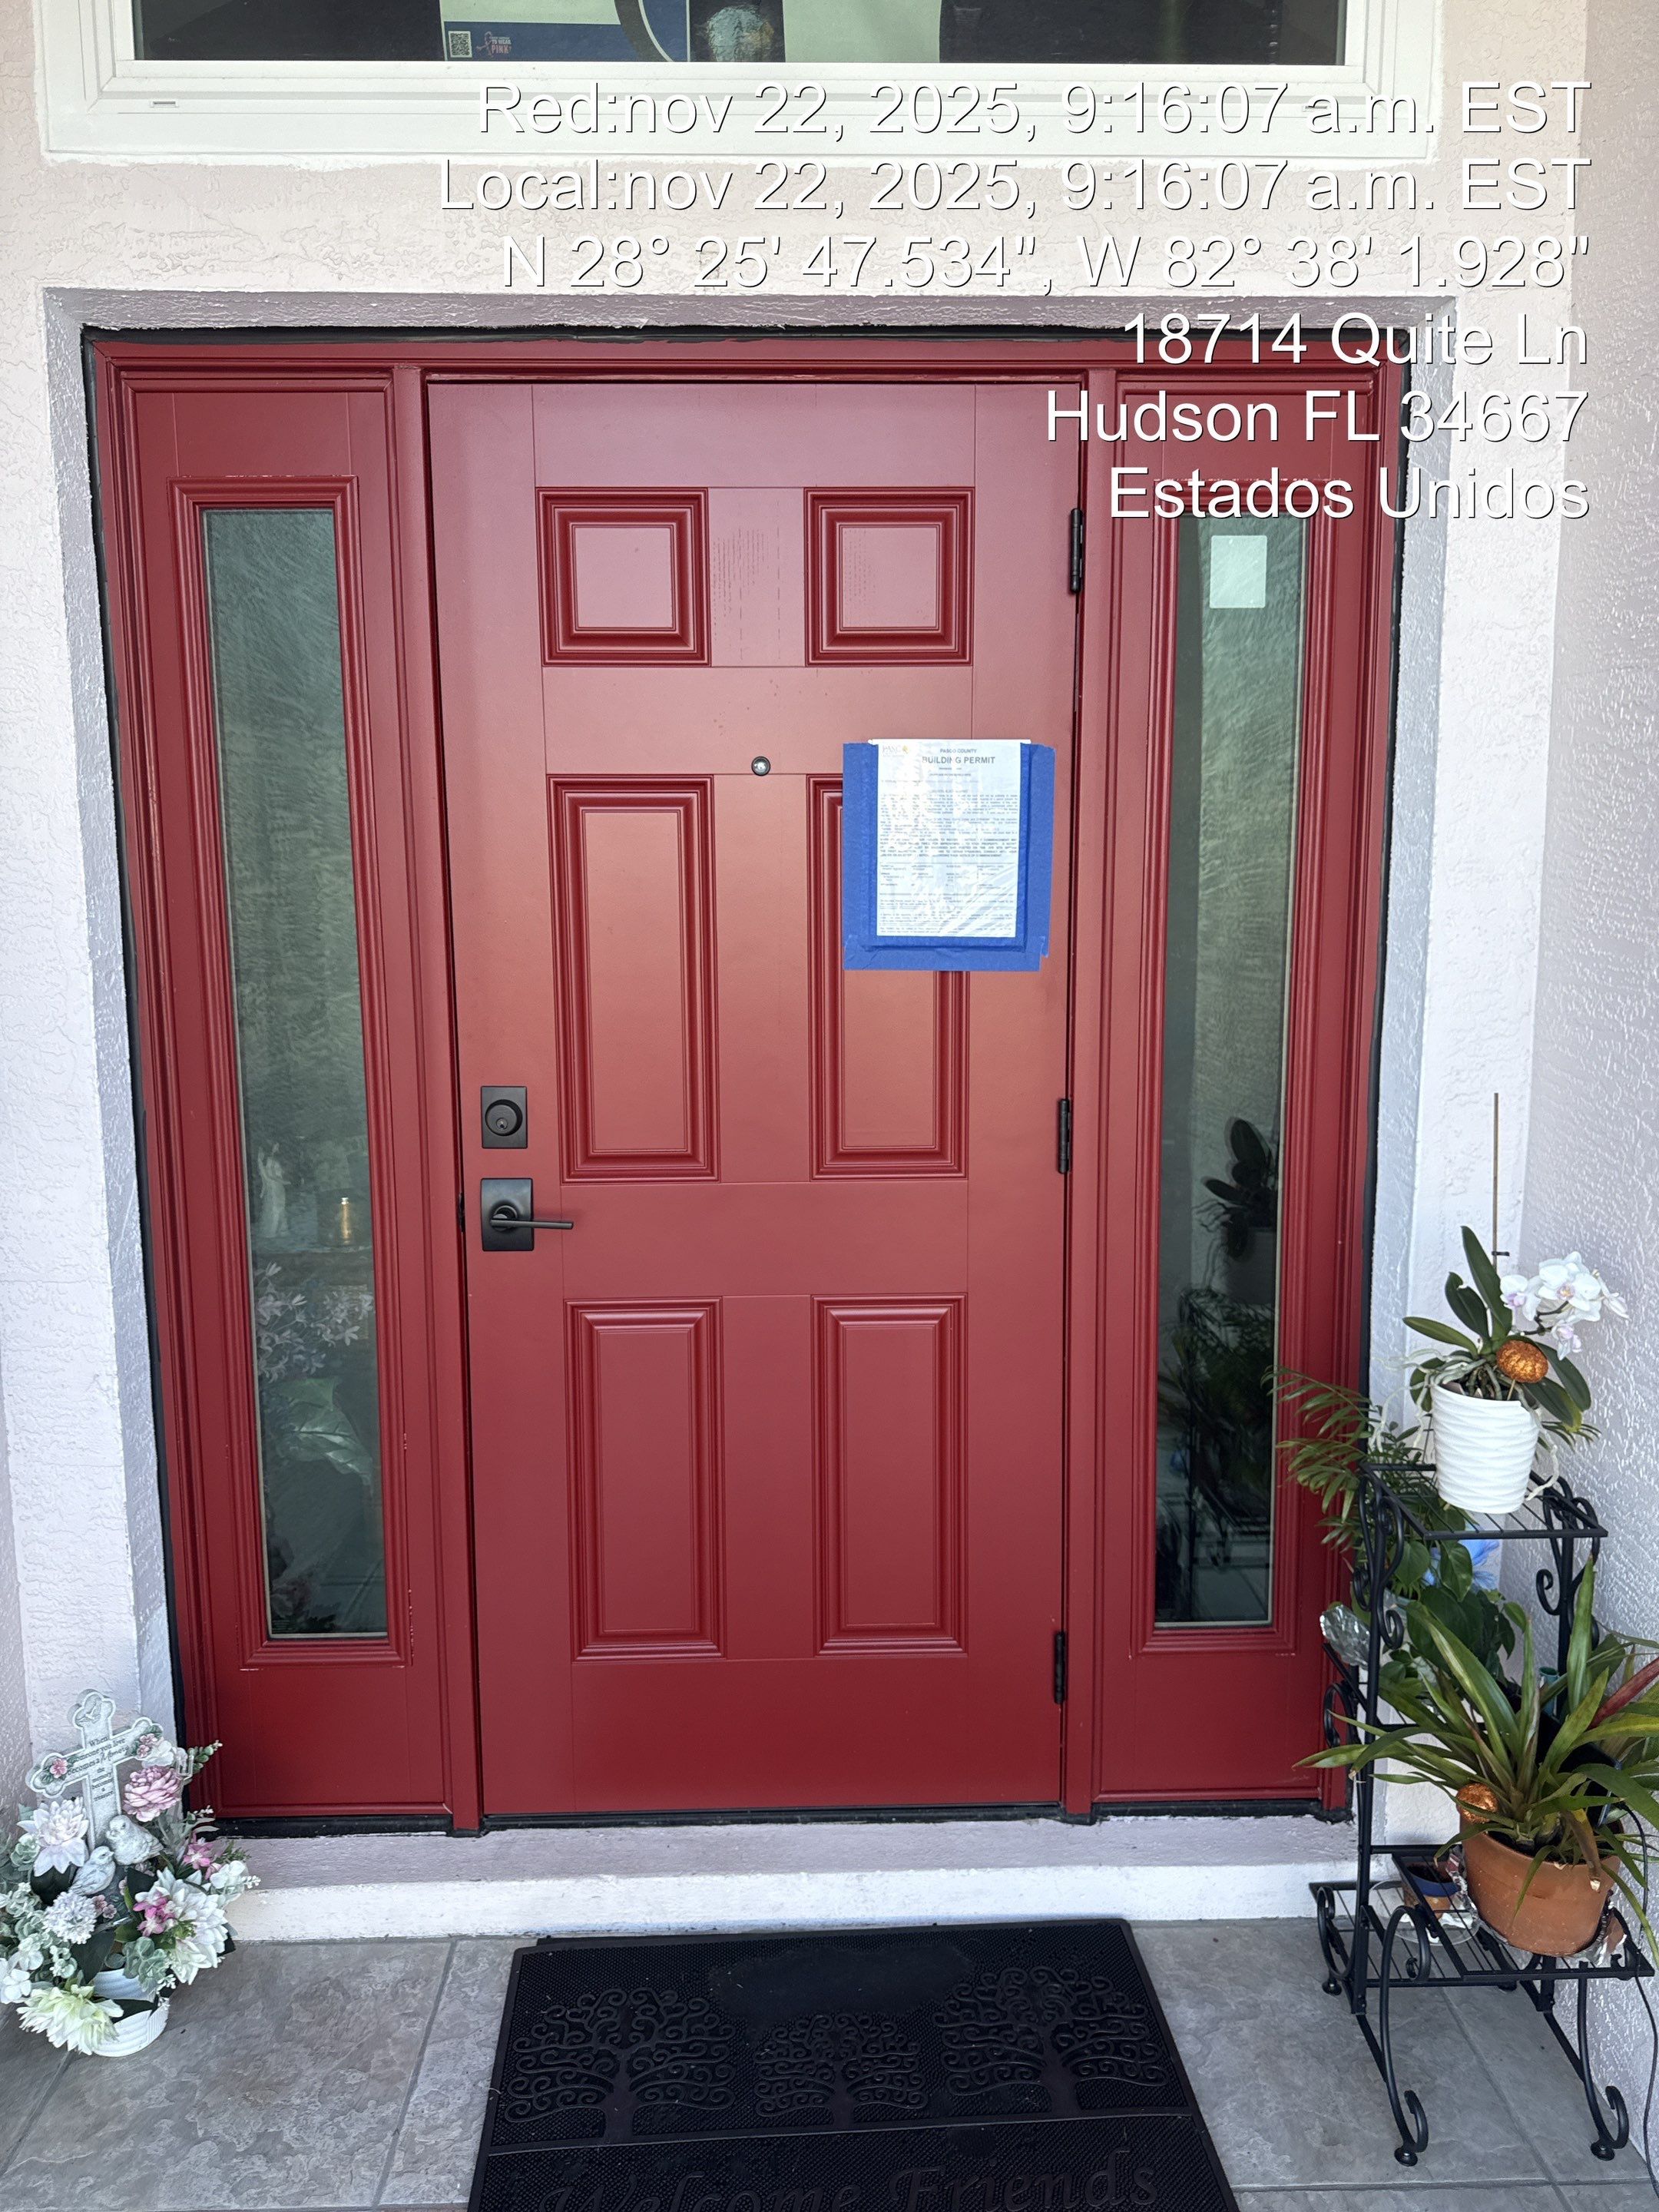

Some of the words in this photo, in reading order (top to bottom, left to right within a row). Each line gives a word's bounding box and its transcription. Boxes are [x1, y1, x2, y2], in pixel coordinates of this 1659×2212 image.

[89, 1737, 109, 1747] When
[100, 1743, 112, 1753] you
[537, 2171, 862, 2212] Welcome
[888, 2150, 1157, 2212] Friends
